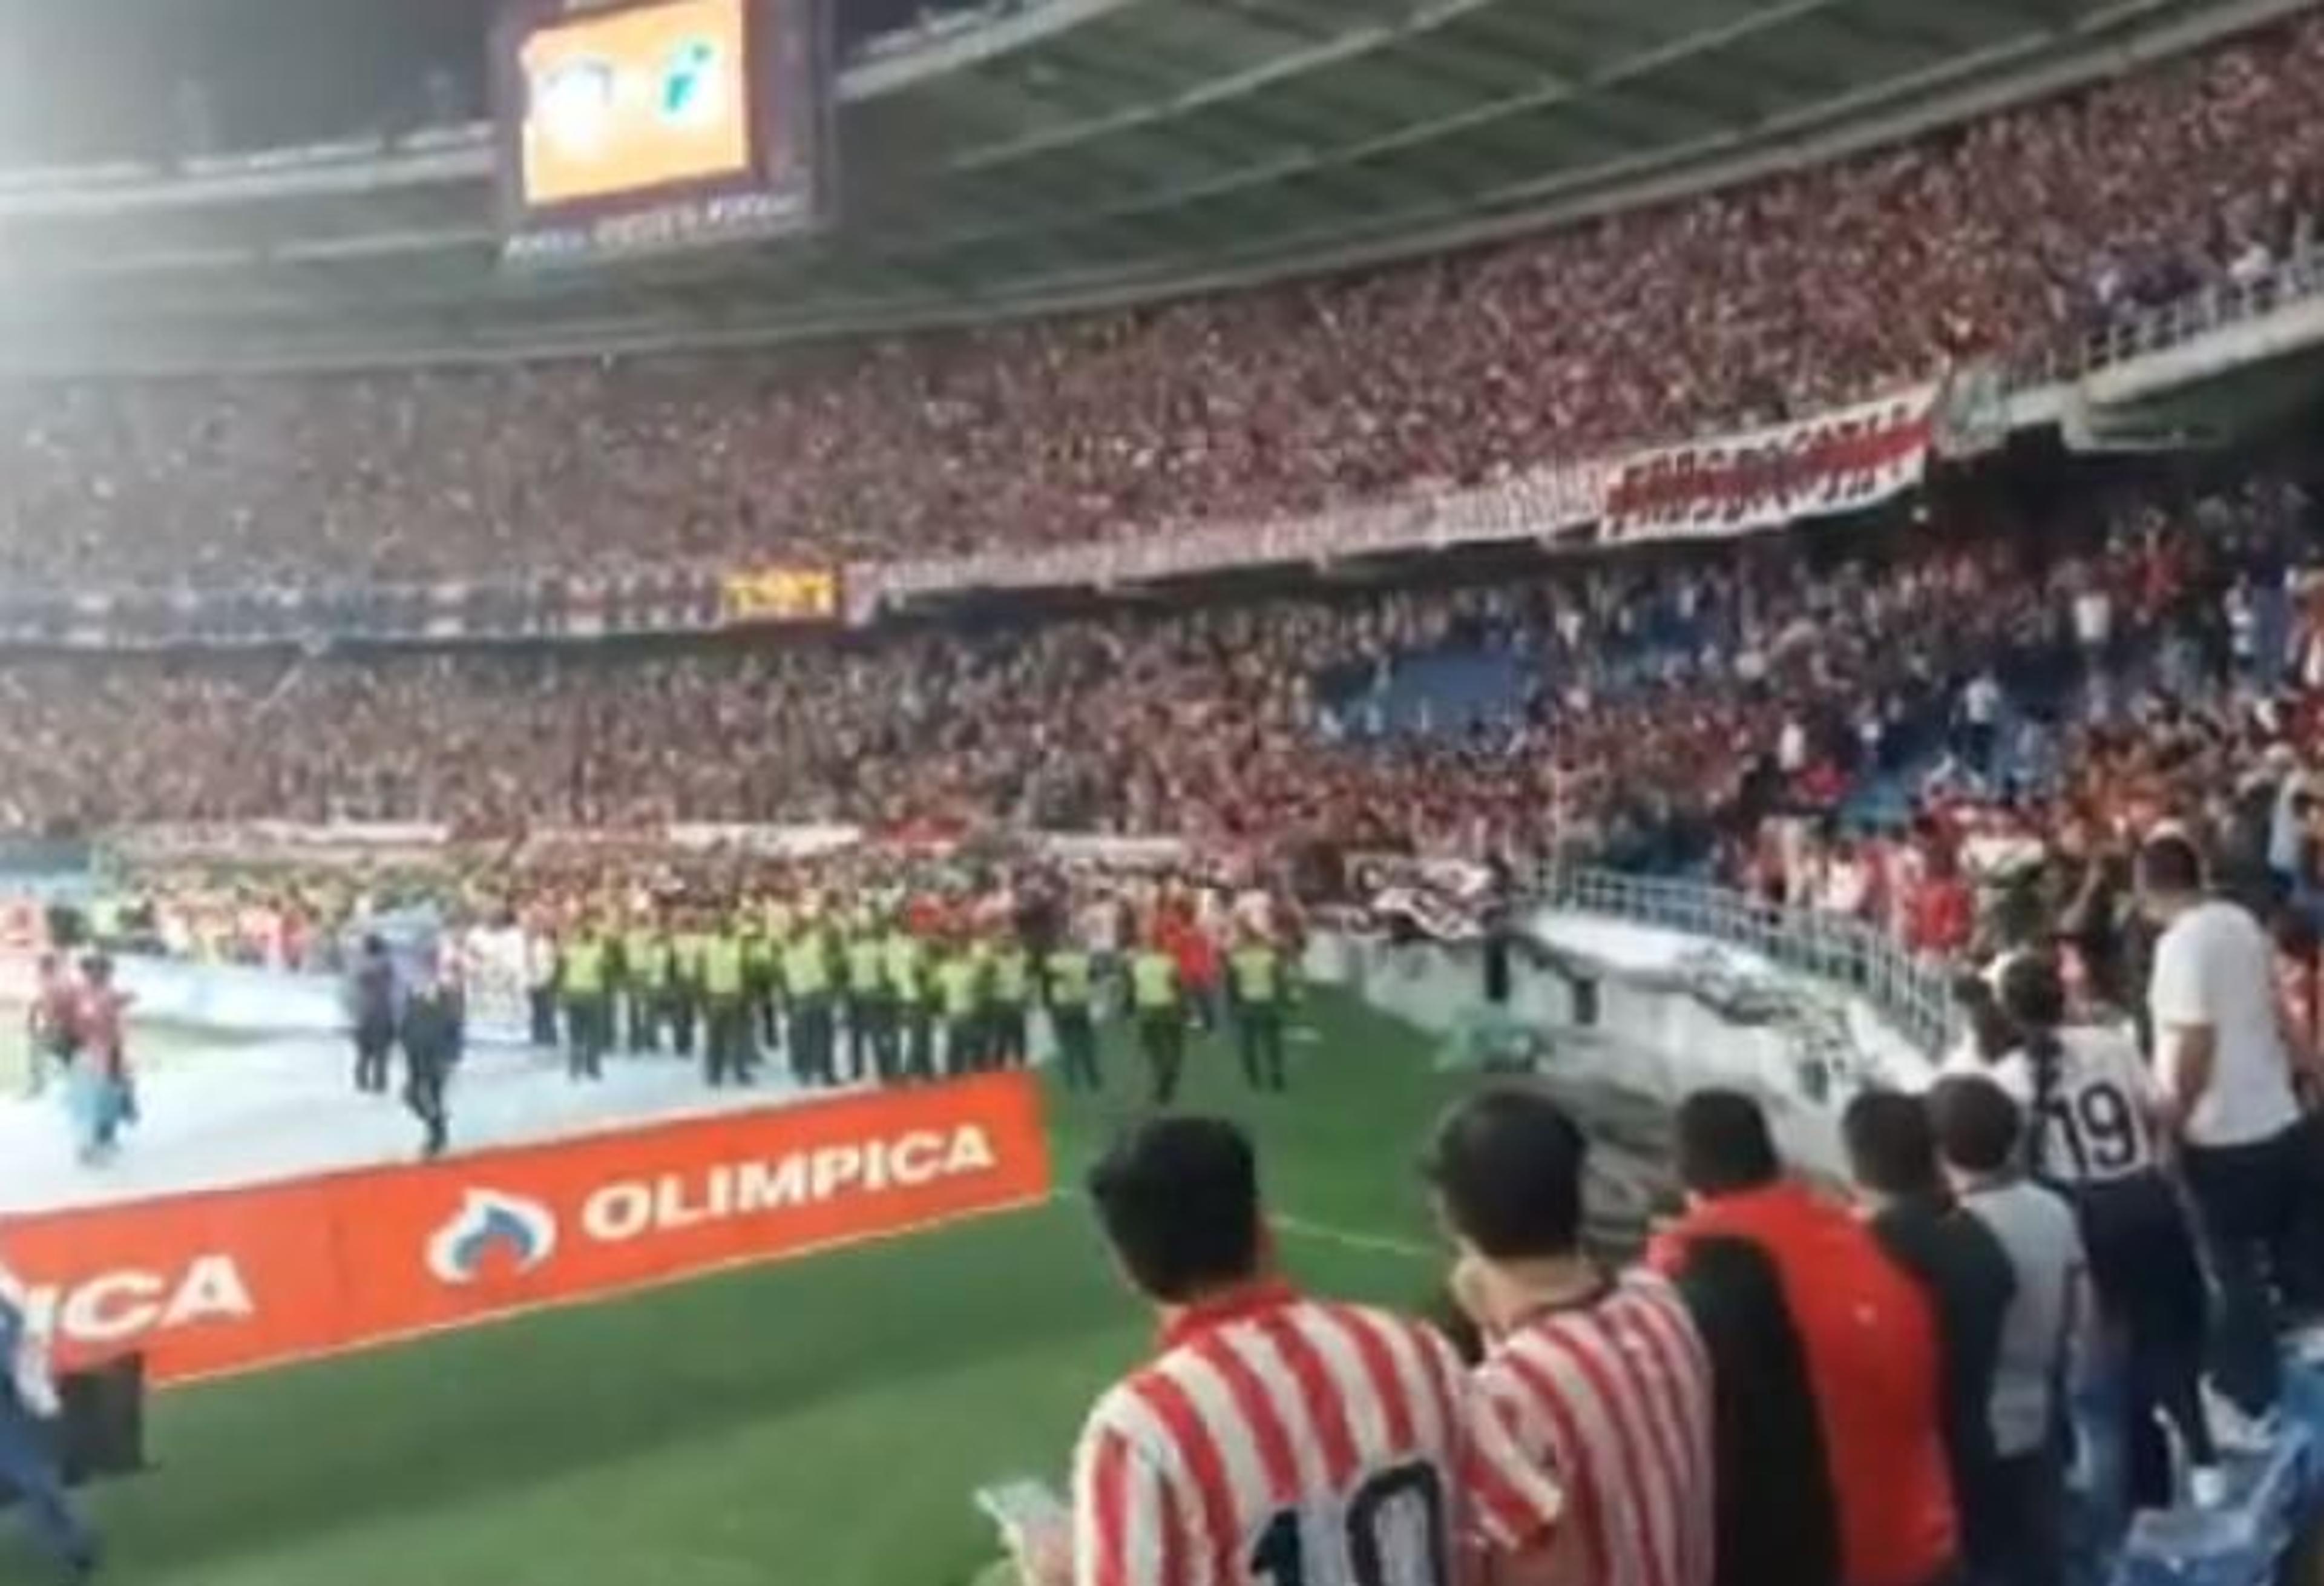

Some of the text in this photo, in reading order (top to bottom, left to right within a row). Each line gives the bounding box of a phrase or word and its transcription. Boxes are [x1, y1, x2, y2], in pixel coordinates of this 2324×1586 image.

[2041, 1080, 2138, 1176] 19
[580, 1125, 996, 1242] OLIMPICA
[25, 1253, 255, 1341] ICA
[1249, 1458, 1448, 1586] 10
